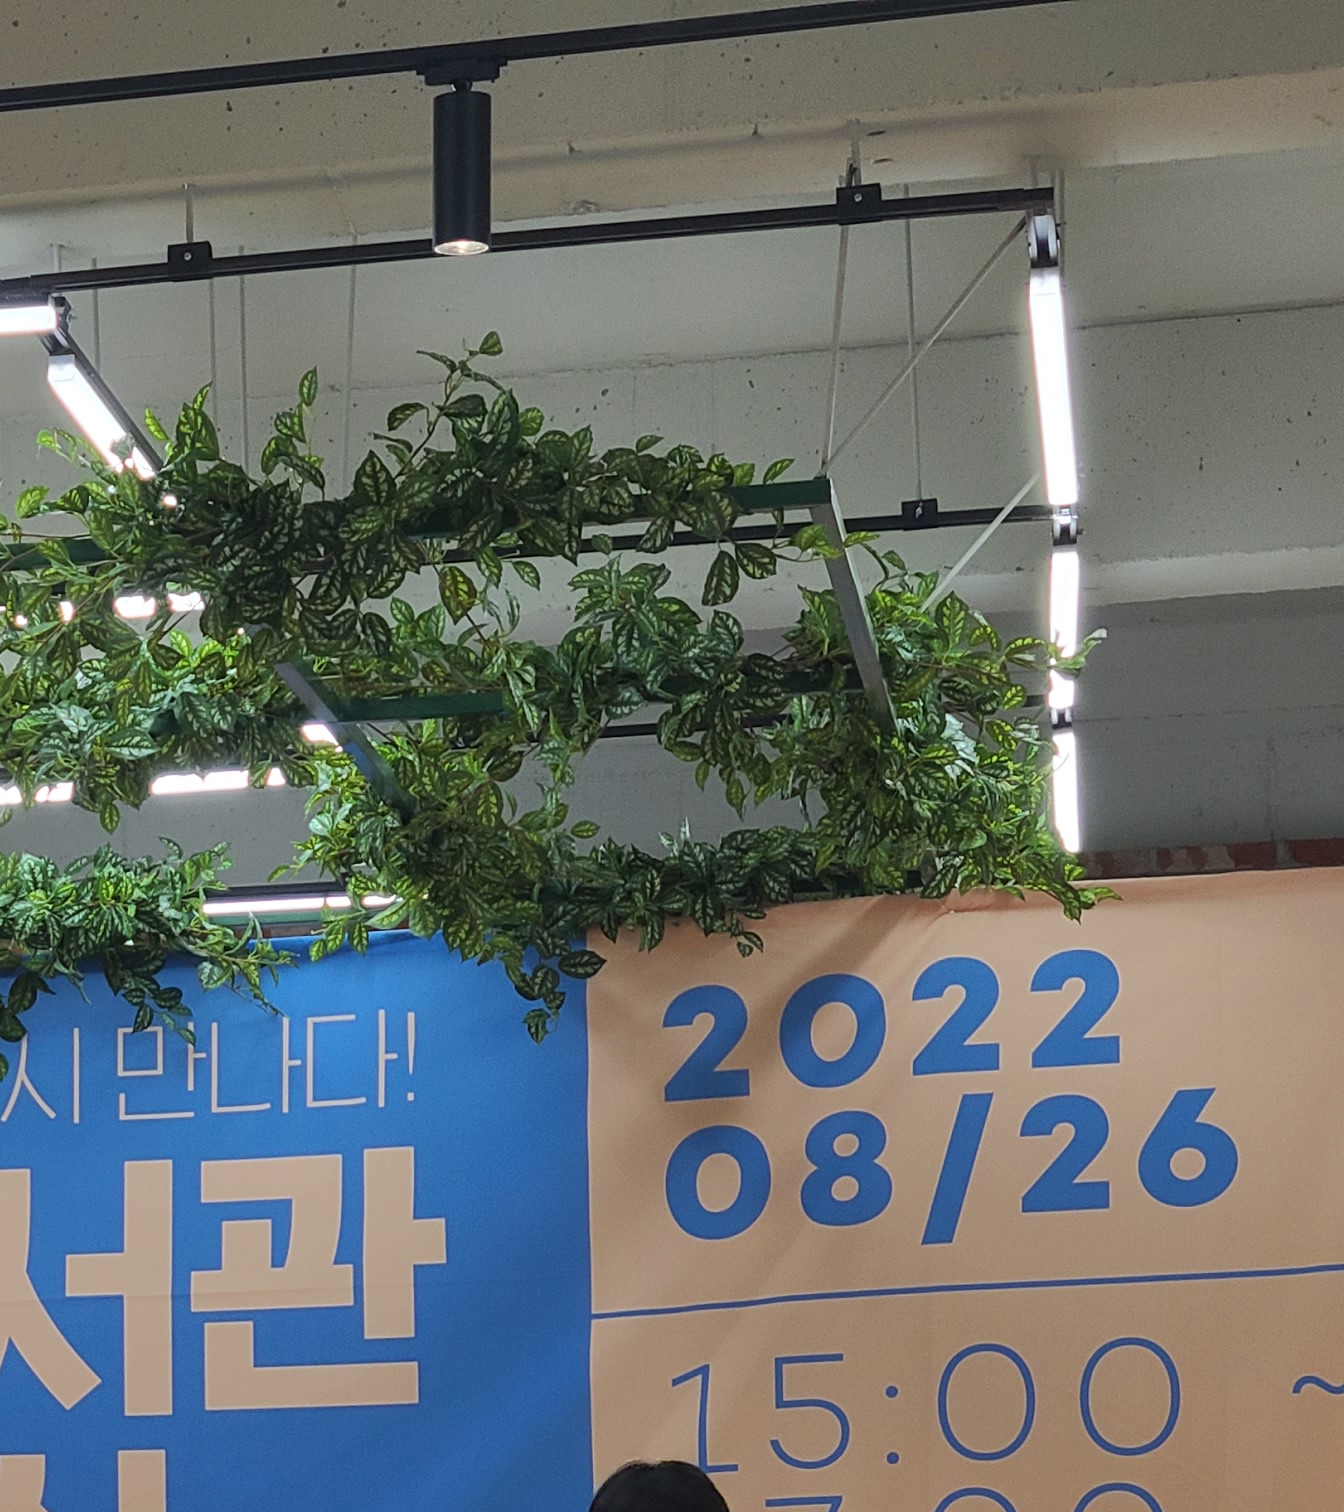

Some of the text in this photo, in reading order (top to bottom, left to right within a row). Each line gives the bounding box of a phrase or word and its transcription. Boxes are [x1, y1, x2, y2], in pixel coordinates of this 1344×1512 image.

[117, 1008, 417, 1121] 만나다!
[662, 949, 1121, 1102] 2022
[664, 1086, 1240, 1246] 08/26
[670, 1336, 1182, 1475] 15:00
